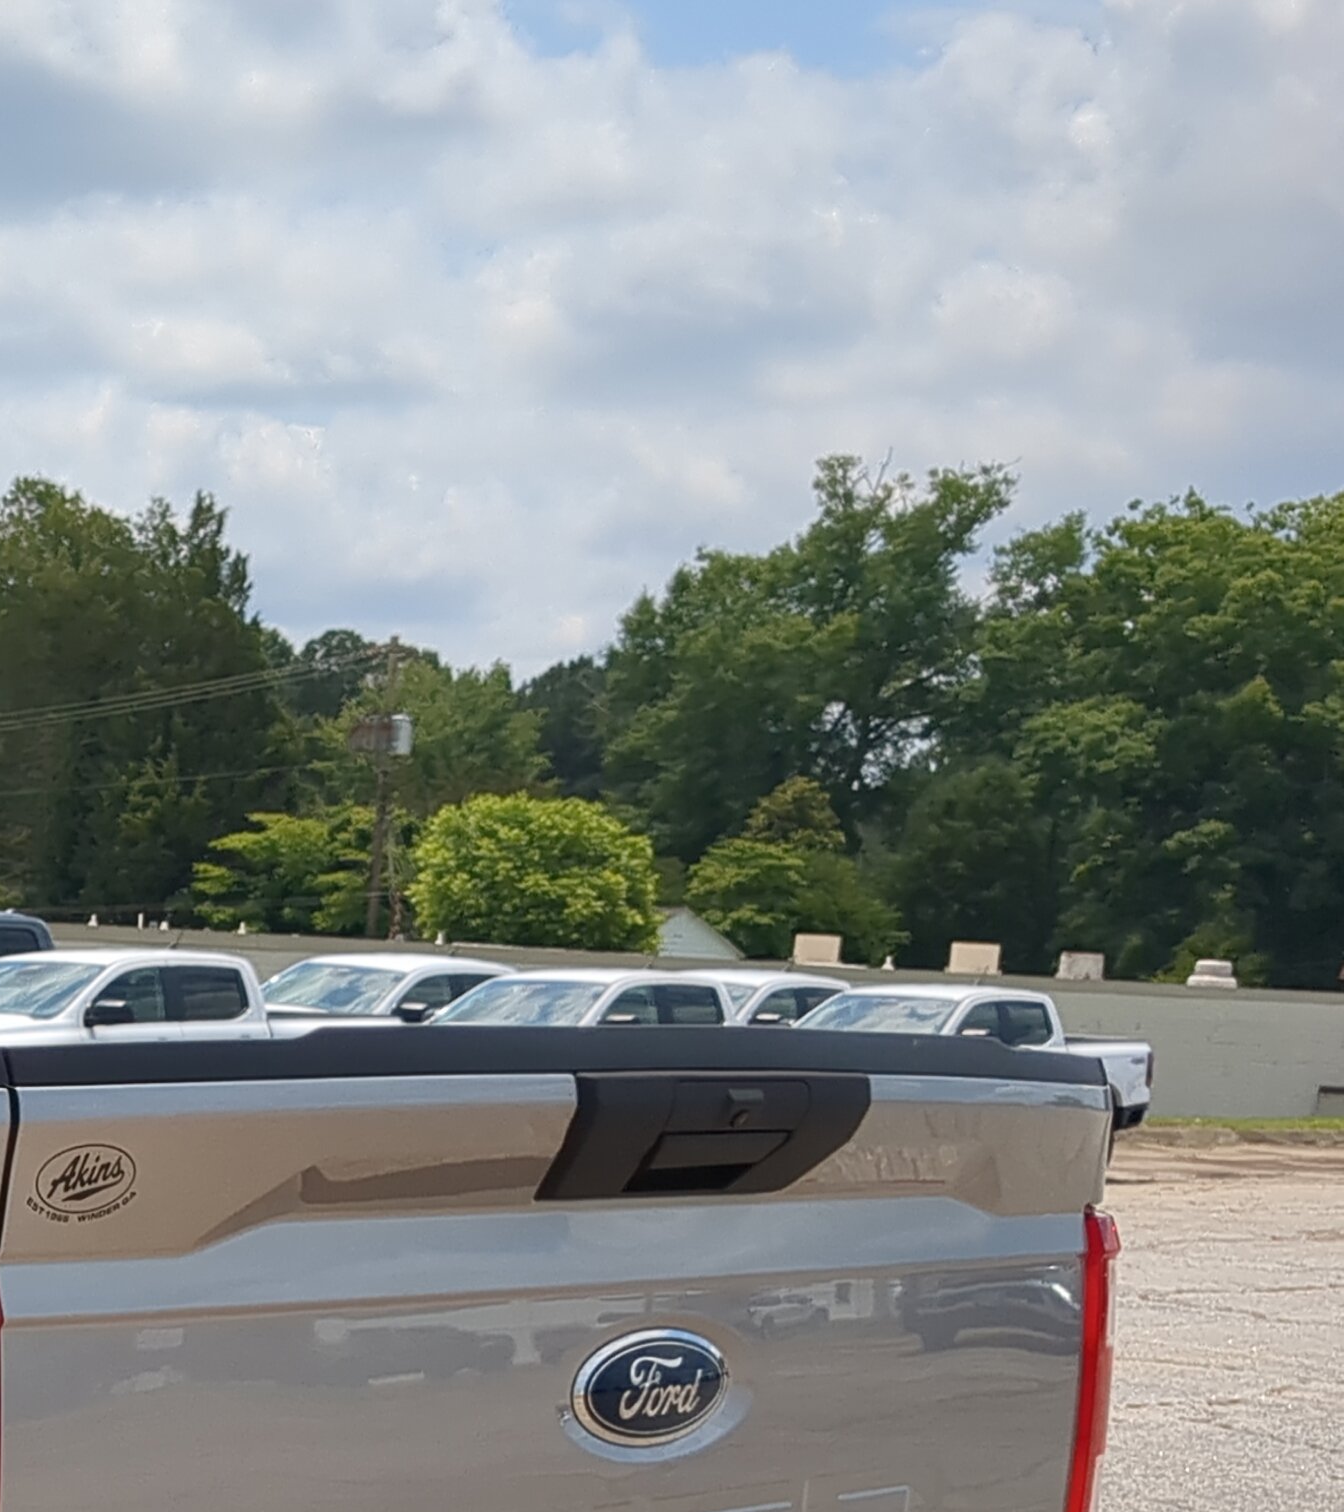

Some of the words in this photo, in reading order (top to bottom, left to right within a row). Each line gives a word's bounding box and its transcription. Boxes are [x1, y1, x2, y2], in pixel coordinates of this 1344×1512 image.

[47, 1152, 125, 1200] Akins
[26, 1196, 45, 1215] EST
[77, 1202, 120, 1223] WINDER
[121, 1191, 137, 1207] GA
[619, 1356, 703, 1420] Ford
